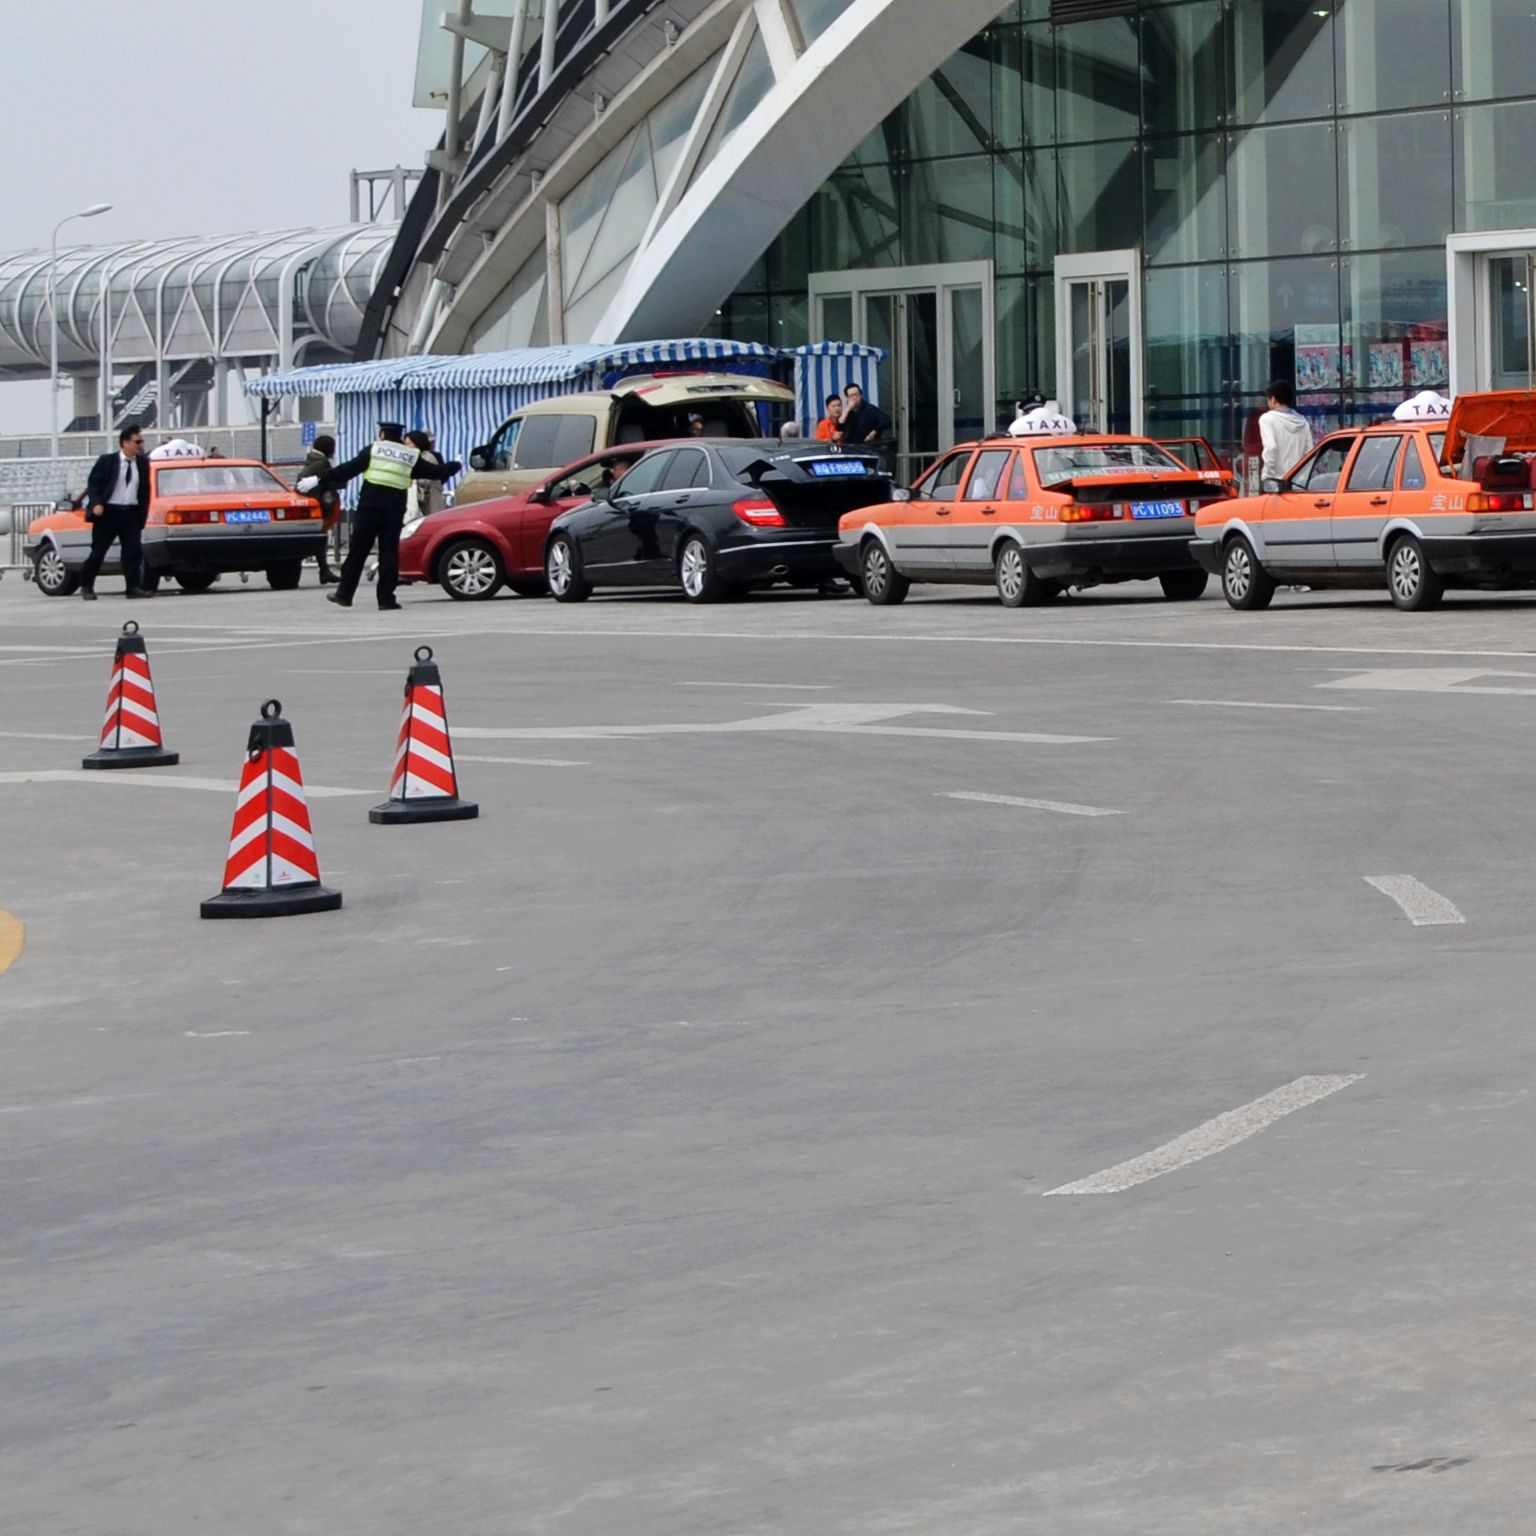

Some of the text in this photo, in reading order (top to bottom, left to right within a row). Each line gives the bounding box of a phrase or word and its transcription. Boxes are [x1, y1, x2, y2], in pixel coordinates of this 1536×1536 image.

[1412, 403, 1449, 416] TAX
[1026, 419, 1068, 431] TAXI
[164, 448, 200, 458] TAXI
[376, 447, 416, 464] POLICE
[1430, 492, 1463, 511] 宝山
